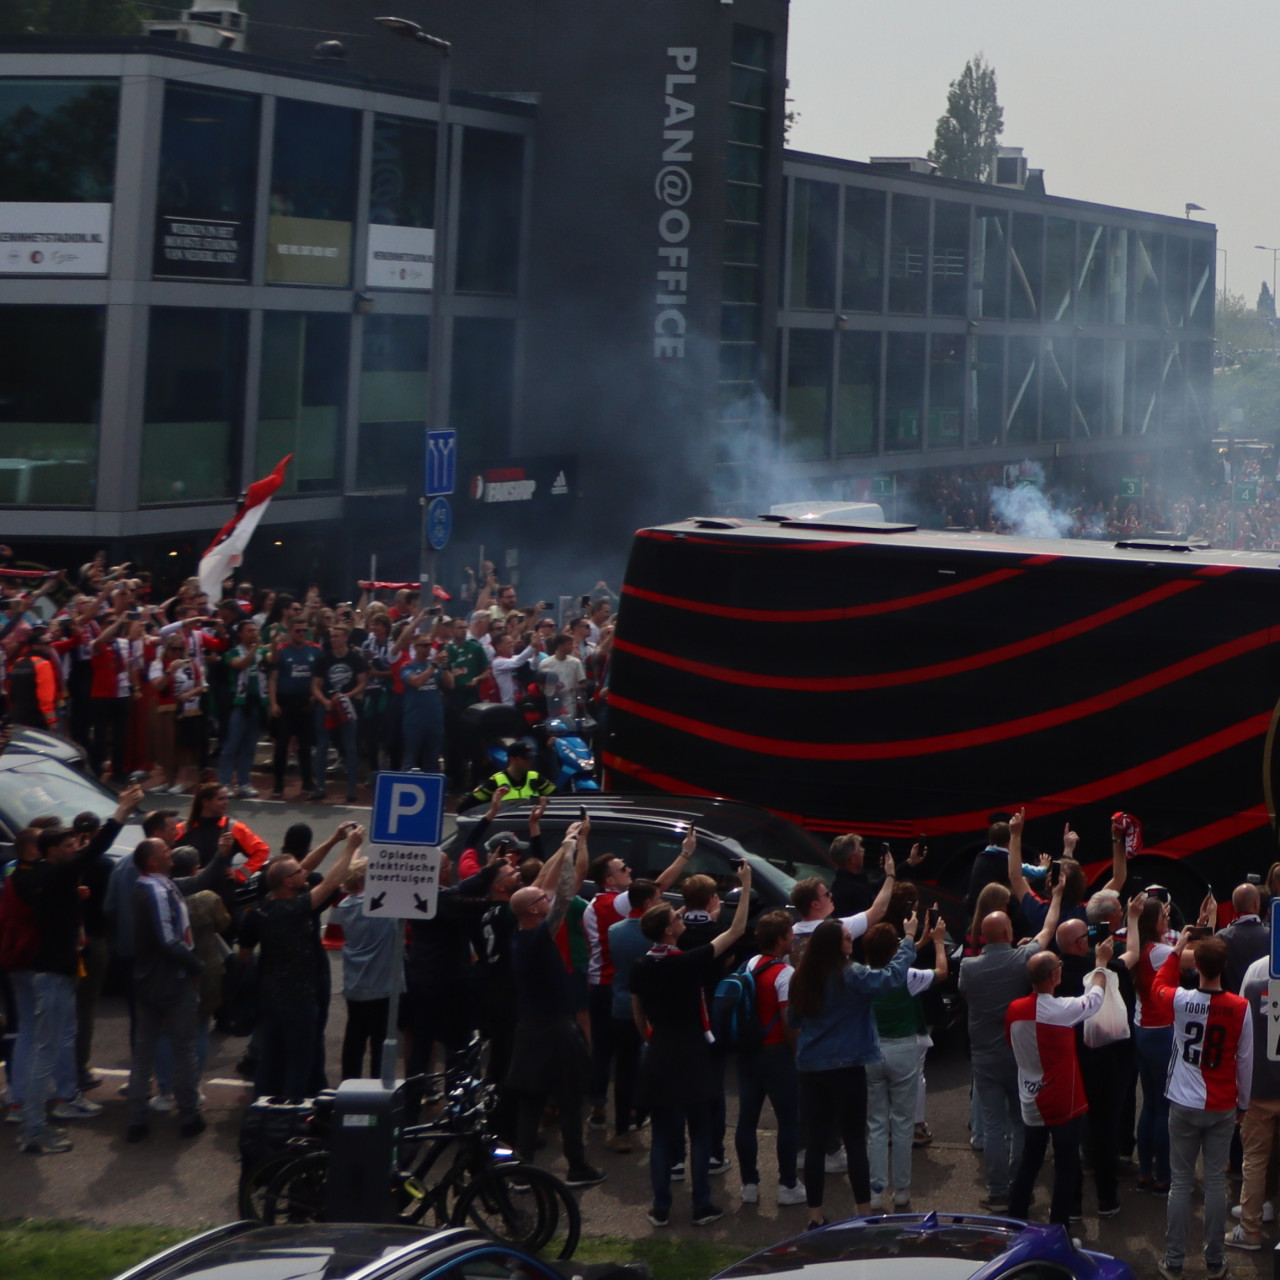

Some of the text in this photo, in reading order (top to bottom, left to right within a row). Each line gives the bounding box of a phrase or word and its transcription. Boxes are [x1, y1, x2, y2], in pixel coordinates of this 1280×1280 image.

[653, 46, 698, 358] PLAN@OFFICE
[387, 783, 426, 834] P
[369, 861, 436, 873] elektrische
[379, 850, 428, 861] Opladen
[369, 873, 434, 885] voertuigen
[1182, 1021, 1226, 1069] 28
